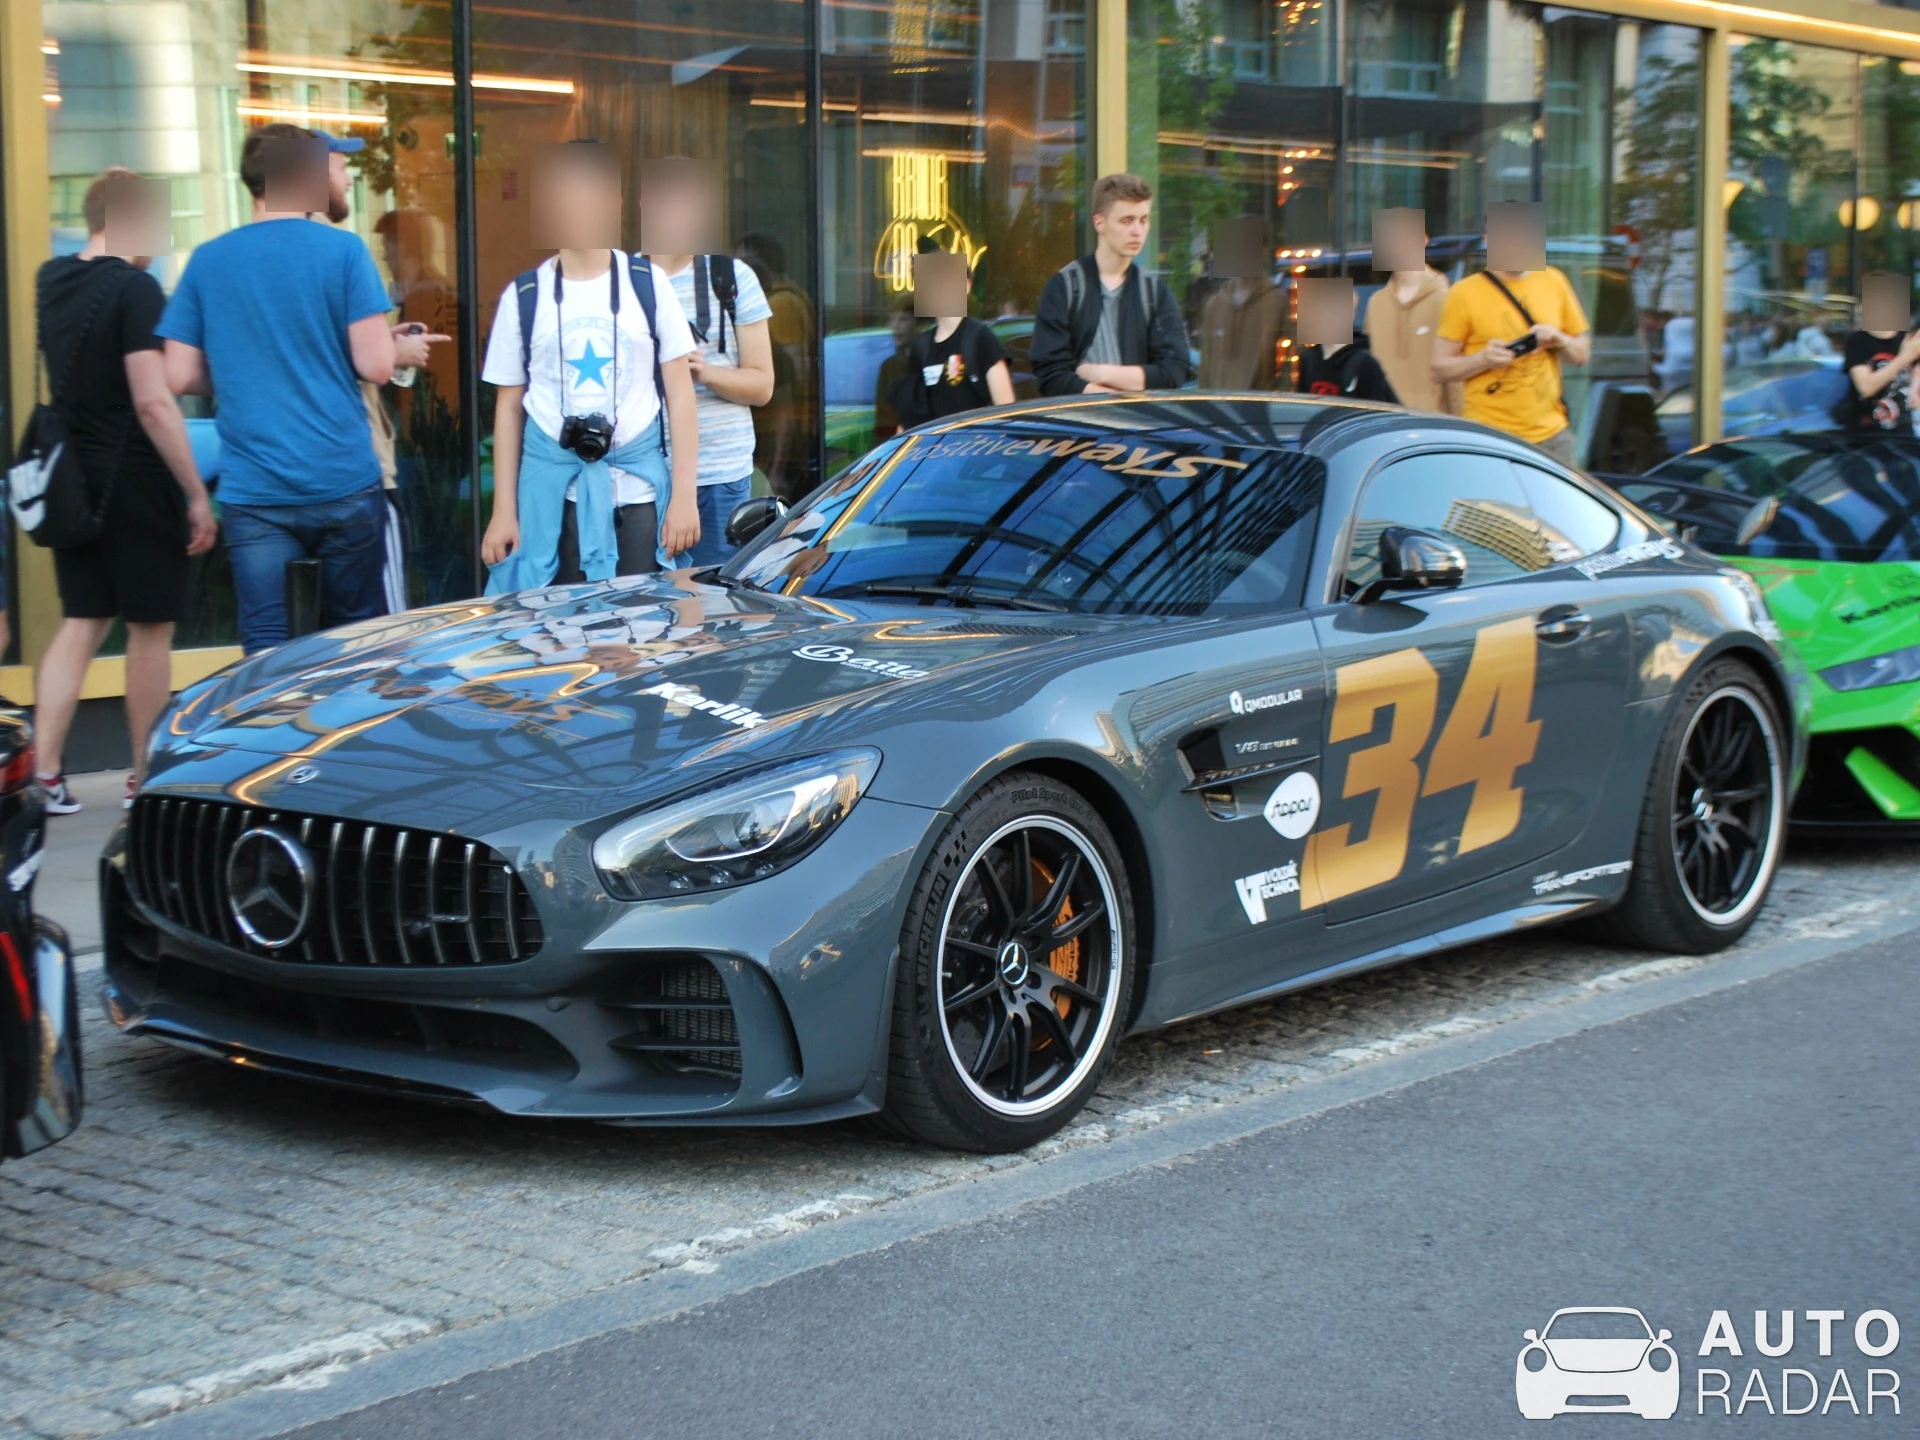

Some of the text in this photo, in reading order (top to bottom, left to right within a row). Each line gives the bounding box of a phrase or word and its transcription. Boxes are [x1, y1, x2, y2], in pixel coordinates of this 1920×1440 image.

[645, 682, 770, 729] Karlik
[1244, 688, 1303, 713] QMODULAR
[1235, 741, 1259, 754] V8
[1300, 616, 1544, 912] 34
[916, 871, 950, 987] MICHELIN
